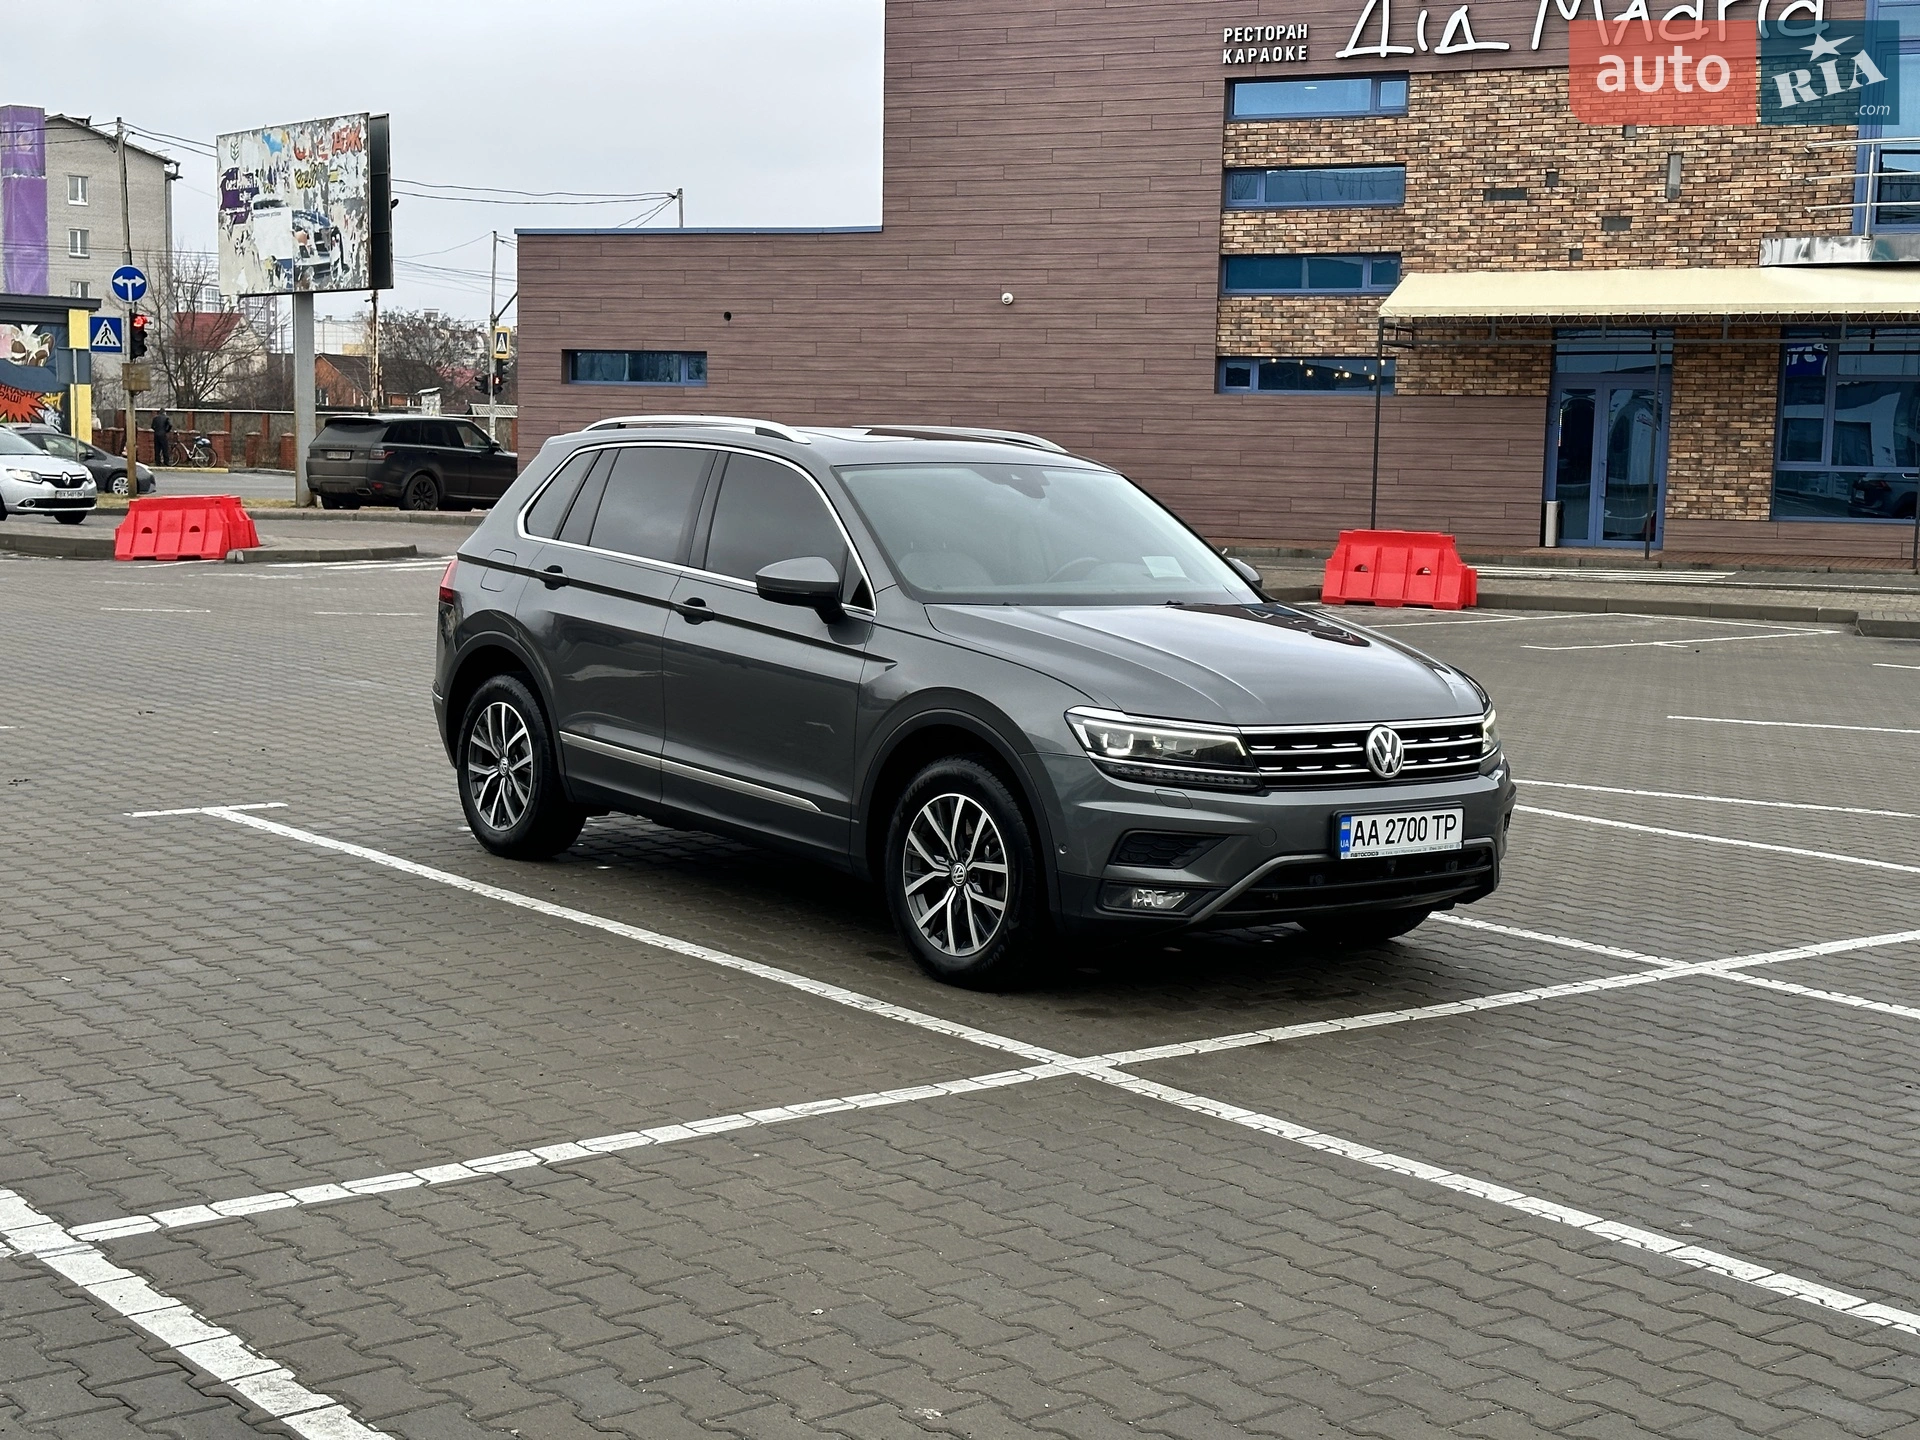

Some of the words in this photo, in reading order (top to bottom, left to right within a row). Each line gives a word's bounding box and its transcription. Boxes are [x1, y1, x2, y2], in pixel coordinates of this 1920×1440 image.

[1223, 23, 1308, 43] РЕСТОРАН
[1222, 45, 1308, 64] КАРАОКЕ
[1352, 819, 1380, 847] AA
[1385, 816, 1428, 845] 2700
[1432, 814, 1457, 840] TP
[1340, 839, 1350, 848] UA
